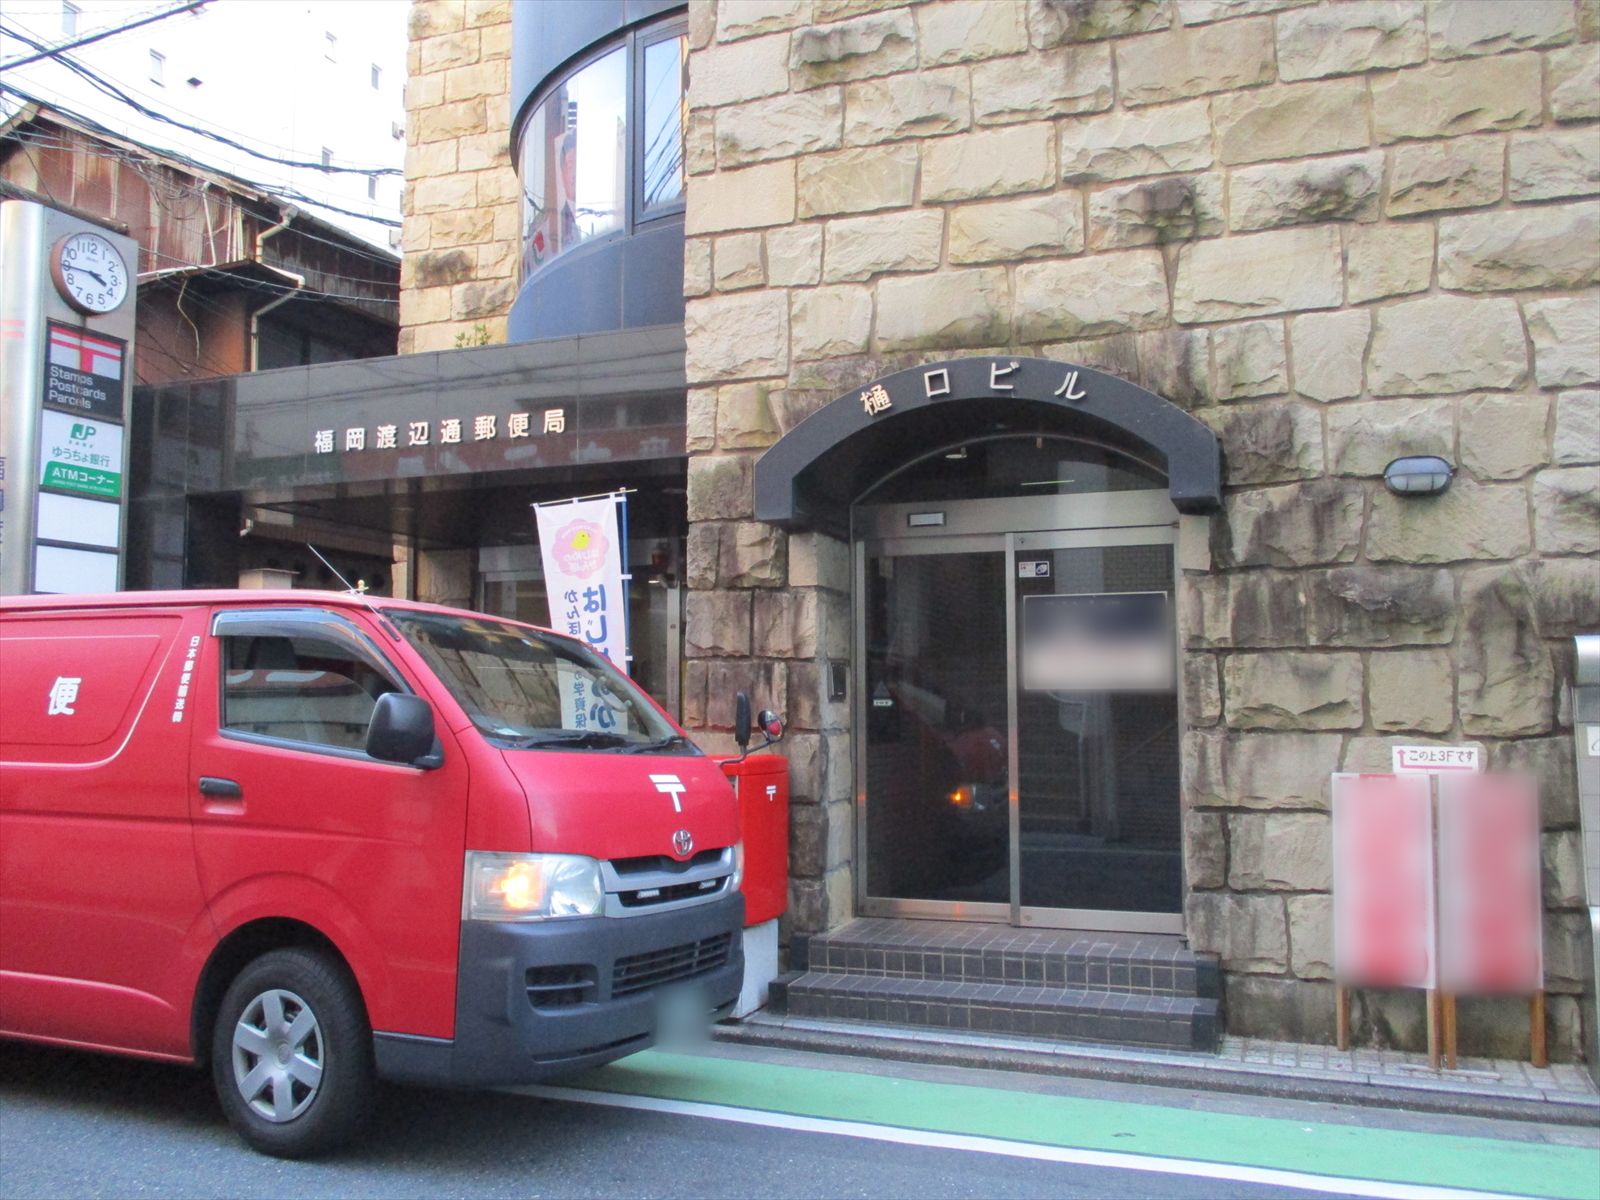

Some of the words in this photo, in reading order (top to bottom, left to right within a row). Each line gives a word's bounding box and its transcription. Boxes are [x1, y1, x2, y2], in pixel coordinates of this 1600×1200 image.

[77, 240, 86, 253] 11
[86, 241, 98, 255] 12
[64, 247, 77, 260] 10
[102, 248, 106, 260] 1
[62, 260, 71, 271] 9
[108, 261, 116, 273] 2
[66, 273, 75, 285] 8
[110, 275, 118, 287] 3
[75, 286, 83, 297] 7
[106, 288, 114, 298] 4
[85, 293, 94, 305] 6
[97, 293, 106, 305] 5
[49, 365, 95, 386] Stamps
[48, 377, 107, 401] Postcards
[860, 361, 1087, 416] 樋口ビル
[48, 389, 92, 409] Parcels
[70, 423, 97, 441] JP
[314, 409, 566, 454] 福岡渡辺通郵便局
[51, 446, 111, 468] ゆうちょ銀行
[52, 467, 115, 485] ATMコーナー
[48, 676, 82, 715] 便
[1409, 750, 1474, 762] この上3Fです
